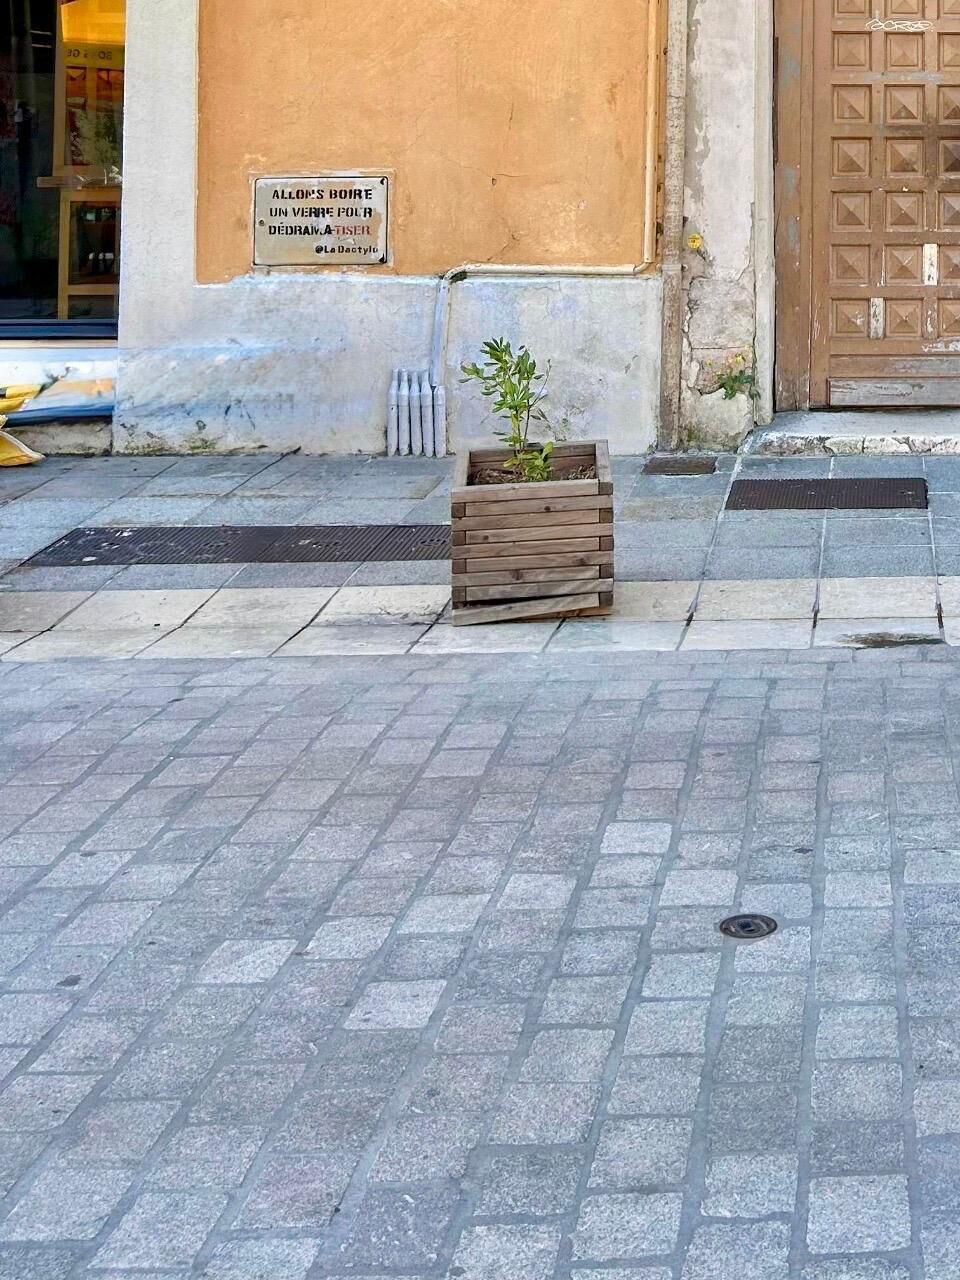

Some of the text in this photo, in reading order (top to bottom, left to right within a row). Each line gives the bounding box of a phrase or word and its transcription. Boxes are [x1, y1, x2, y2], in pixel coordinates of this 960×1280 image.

[329, 189, 373, 200] BOIRE
[269, 207, 288, 218] UN
[292, 207, 334, 218] VERRE
